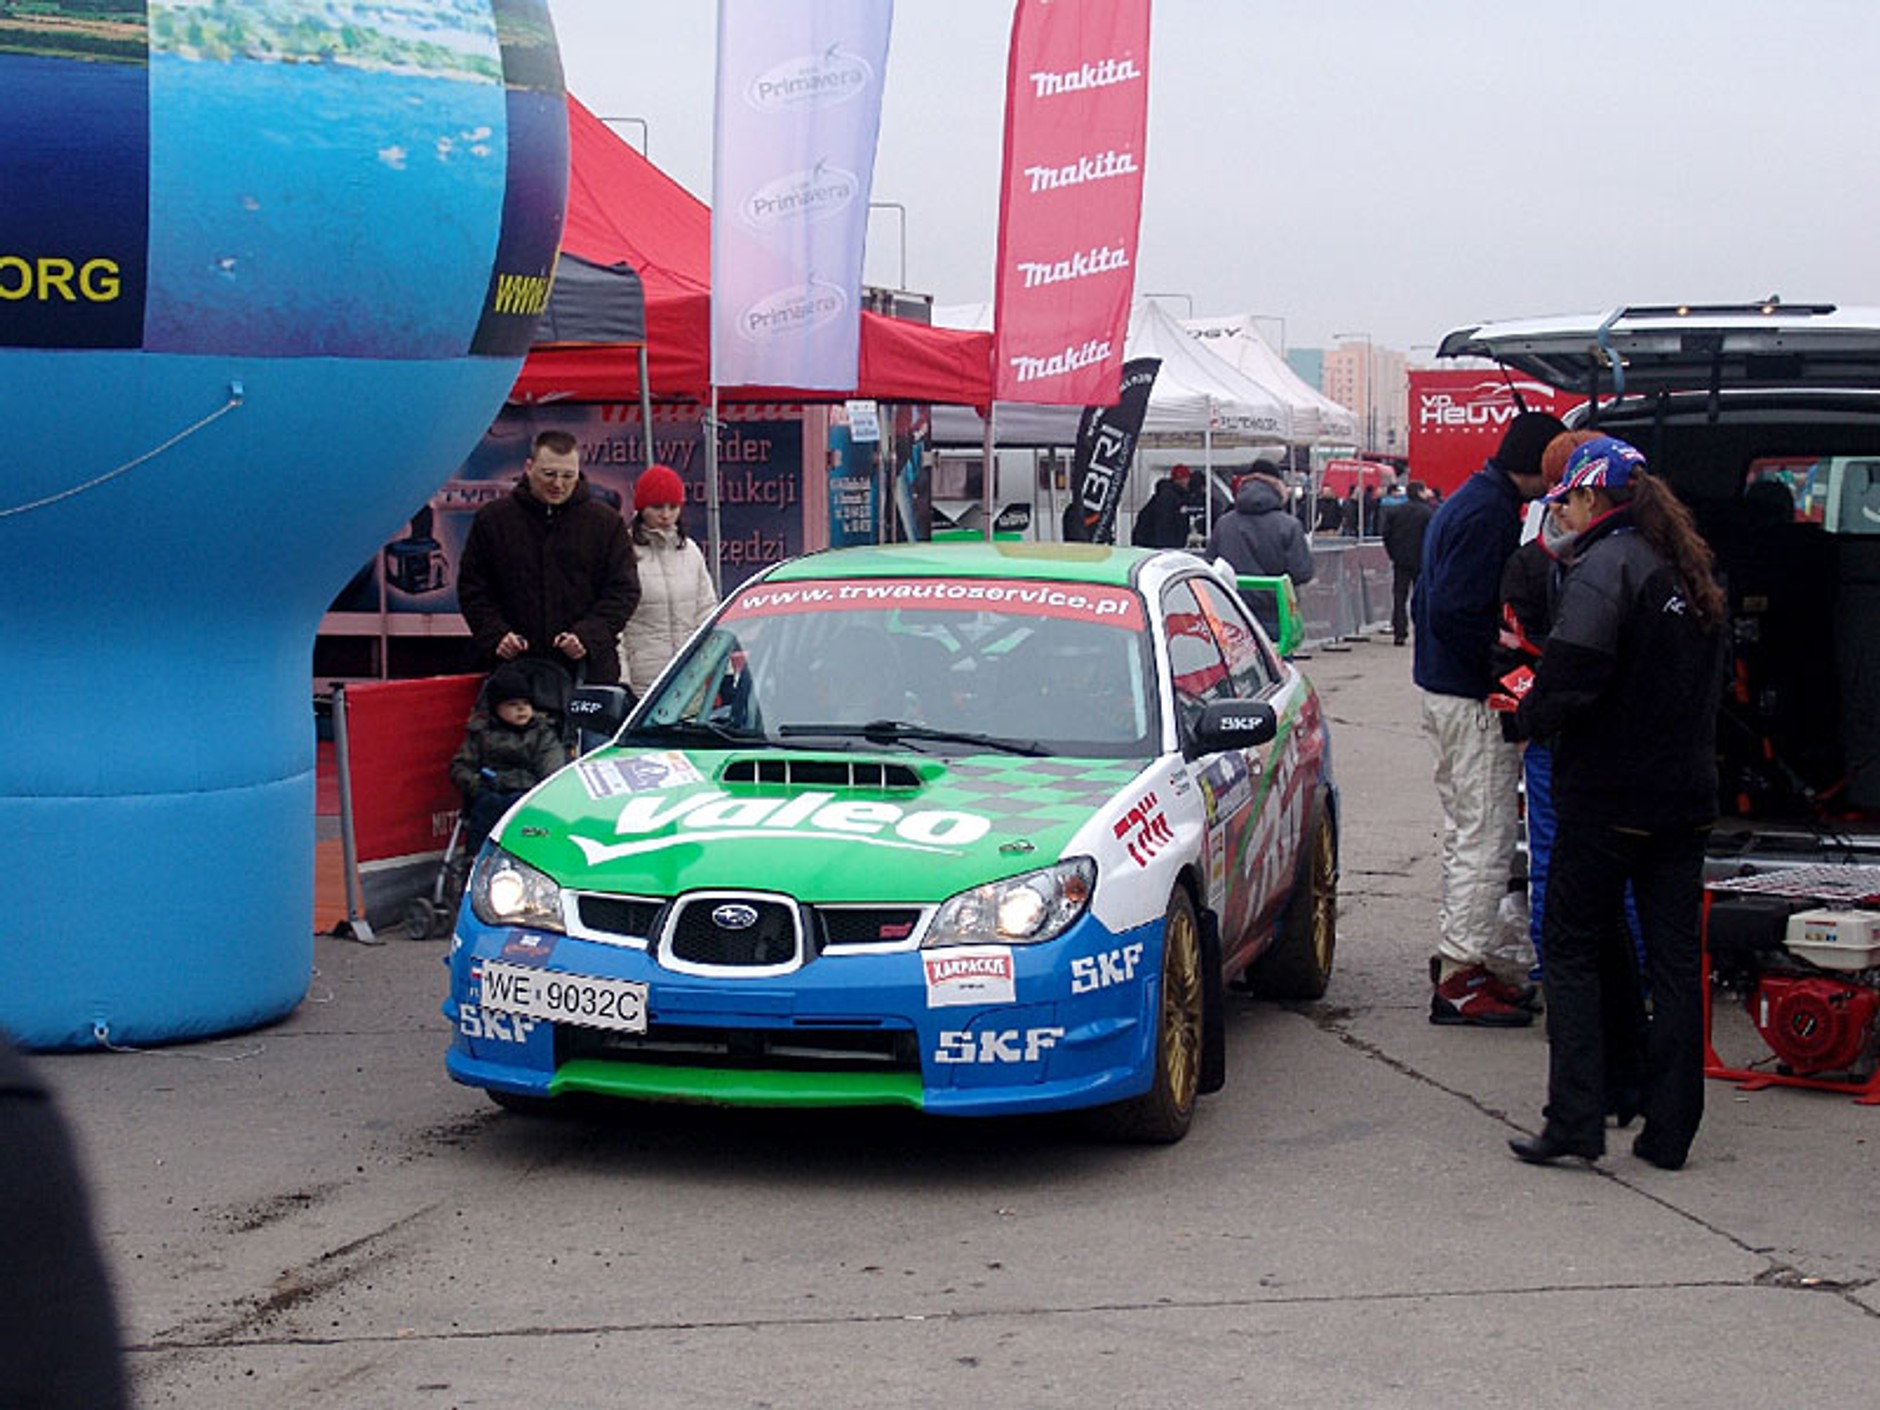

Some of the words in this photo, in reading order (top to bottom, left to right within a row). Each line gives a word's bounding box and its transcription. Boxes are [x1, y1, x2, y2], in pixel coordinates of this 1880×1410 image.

[758, 65, 863, 101] Primavera
[742, 583, 1129, 616] www.trwautoservice.pl
[1220, 717, 1263, 730] SKF
[931, 958, 1006, 979] KARPACKIE
[1071, 943, 1143, 994] SKF
[487, 970, 531, 1005] WE
[547, 981, 639, 1021] 9032C
[934, 1027, 1066, 1064] SKF
